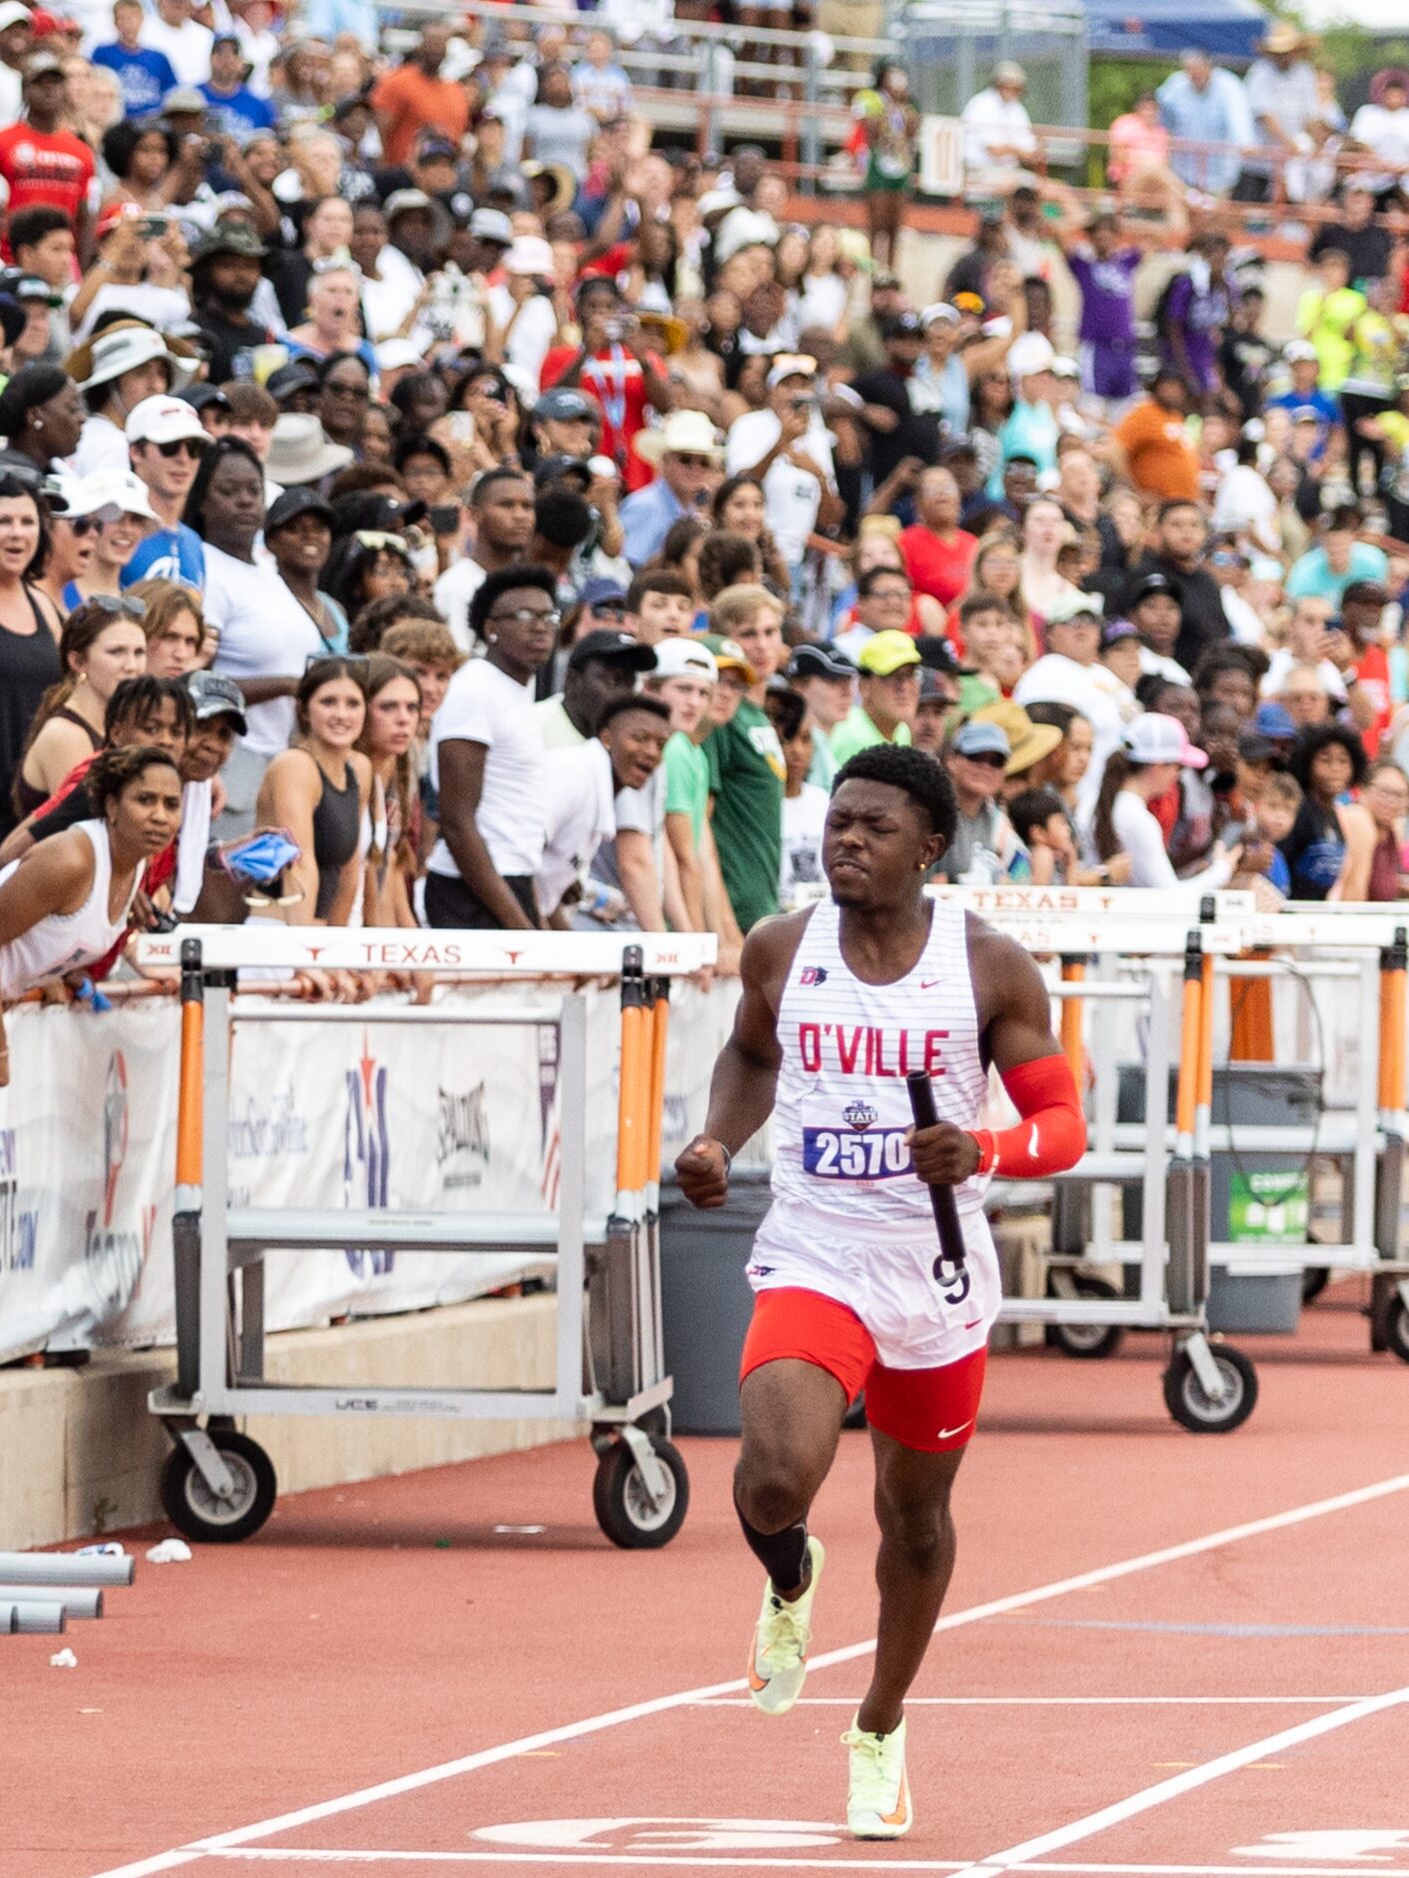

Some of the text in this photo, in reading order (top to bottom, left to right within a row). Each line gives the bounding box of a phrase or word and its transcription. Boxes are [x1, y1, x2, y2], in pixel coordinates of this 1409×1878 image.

[972, 892, 1079, 910] TEXAS
[360, 943, 462, 965] TEXAS
[815, 1132, 910, 1176] 2570
[932, 1254, 970, 1305] 9
